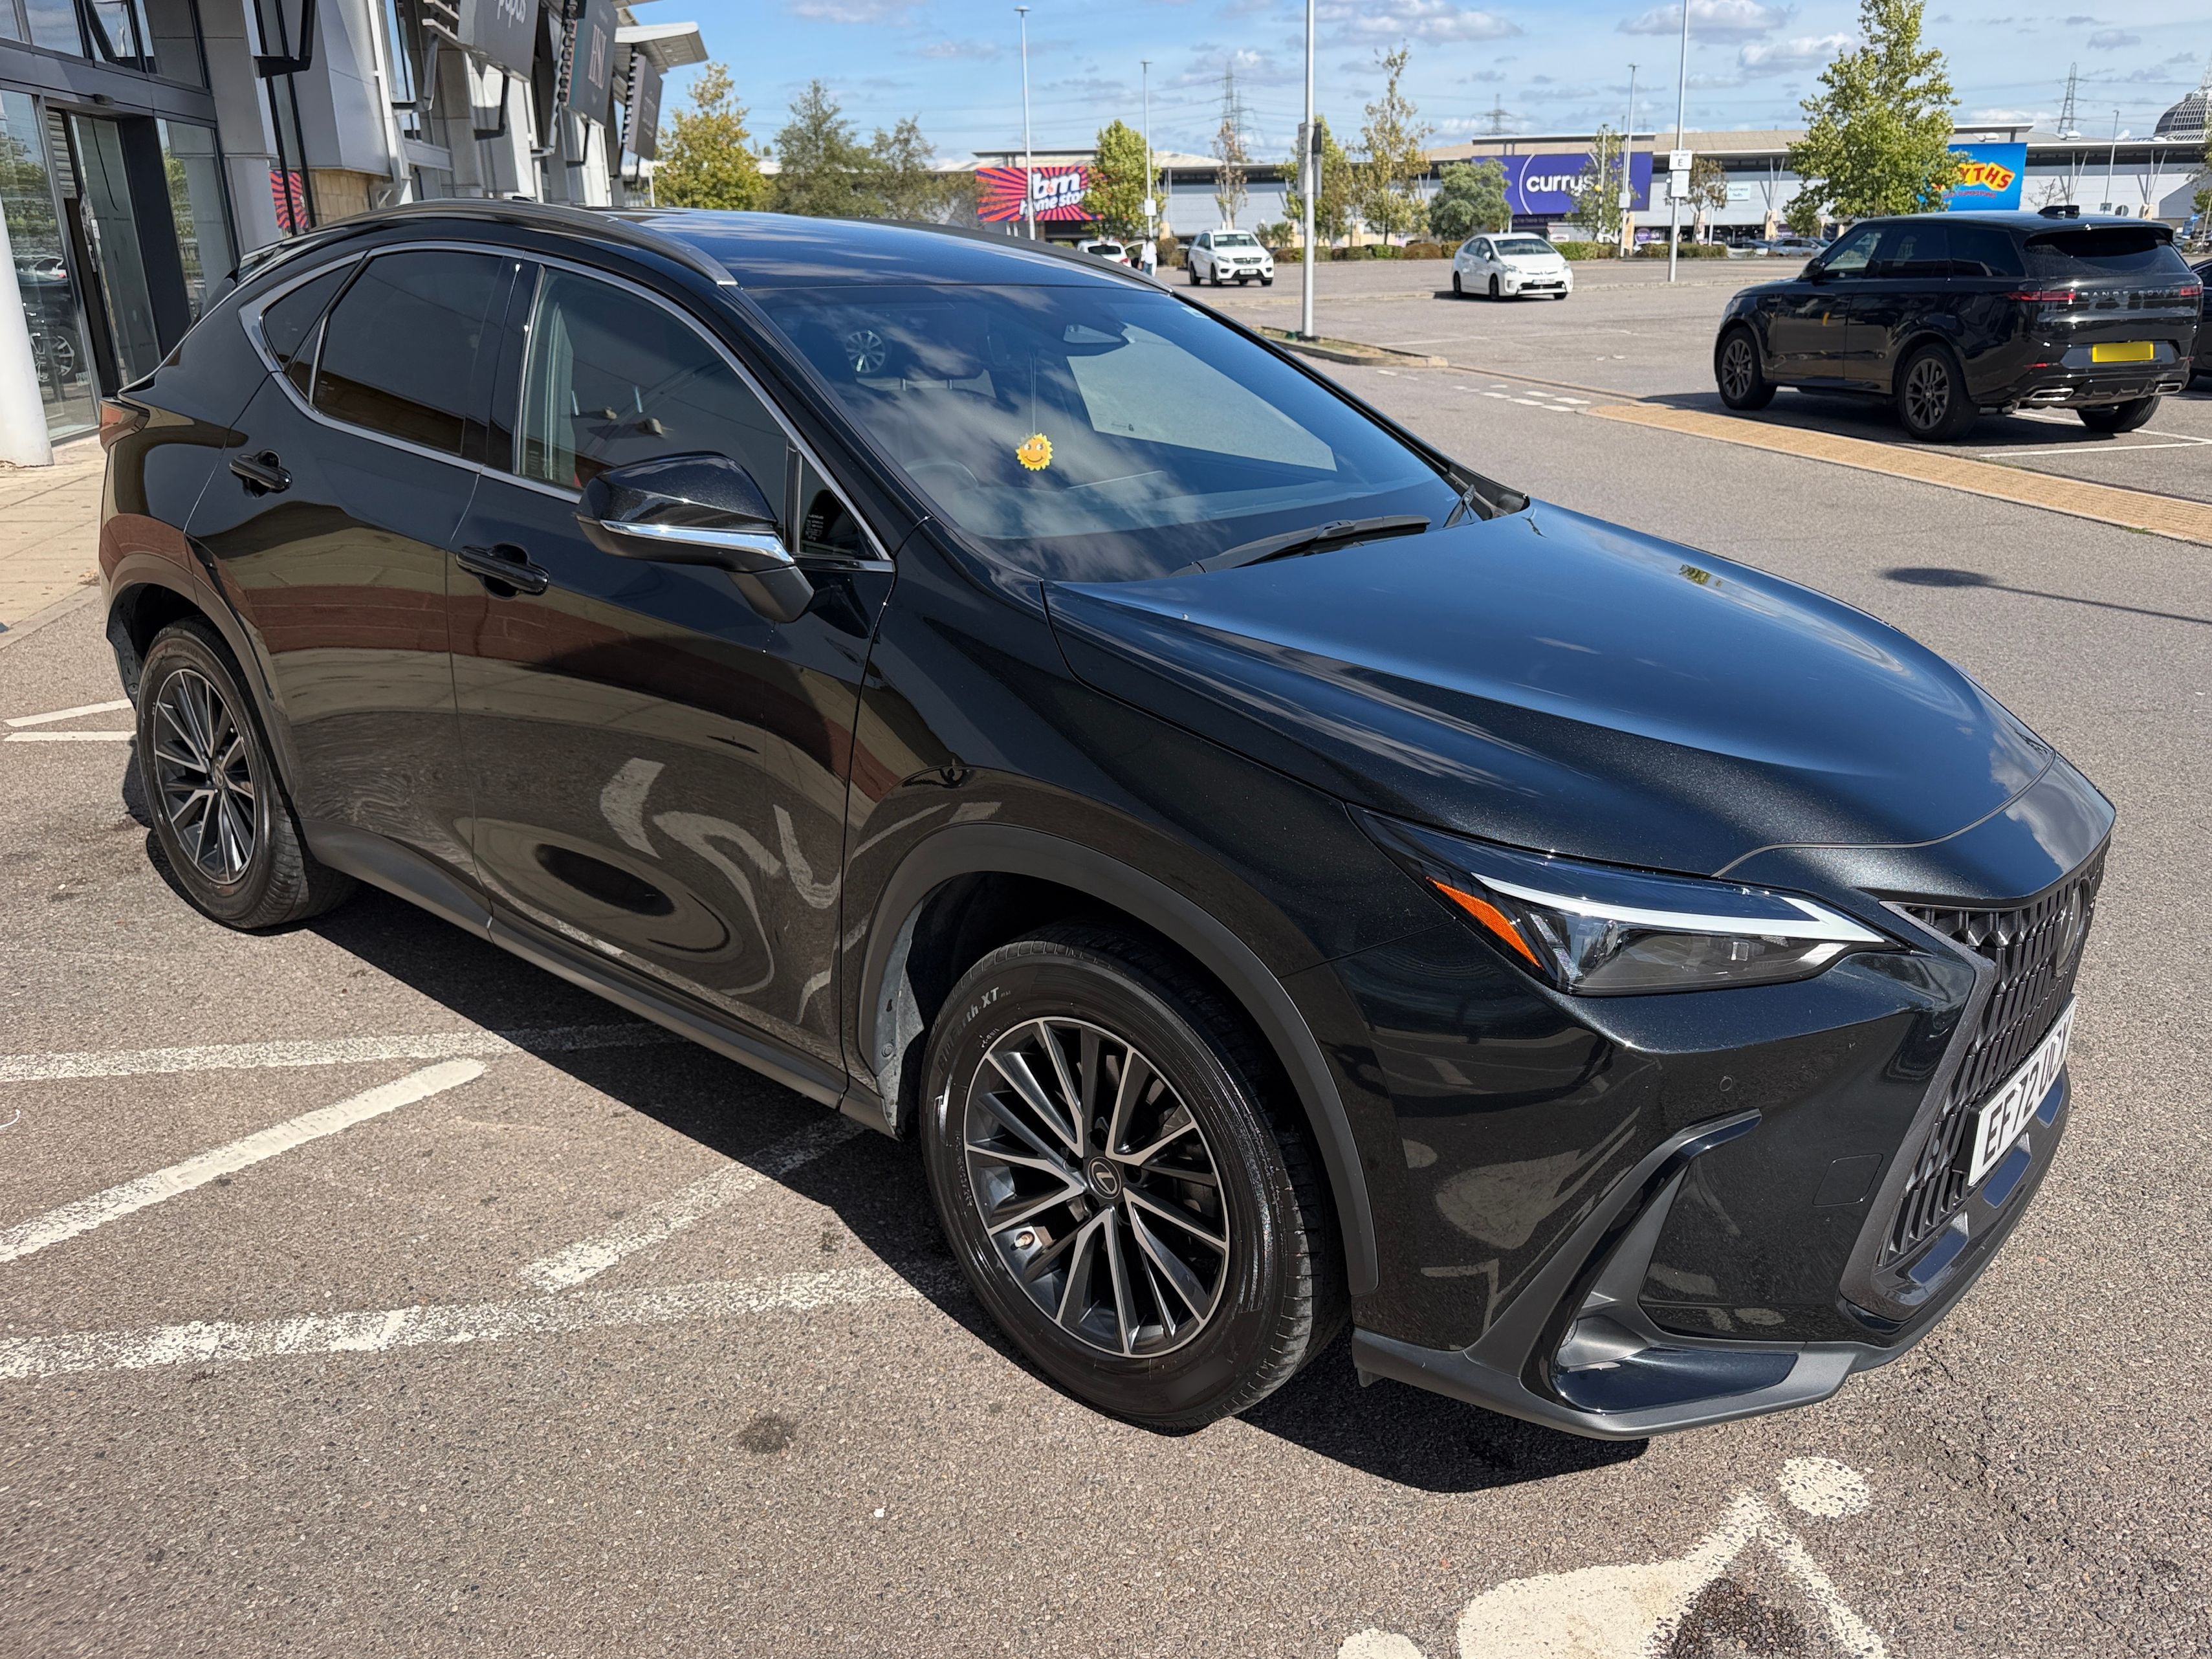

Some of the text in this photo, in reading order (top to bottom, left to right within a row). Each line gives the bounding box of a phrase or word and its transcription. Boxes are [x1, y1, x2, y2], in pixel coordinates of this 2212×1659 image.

[1526, 175, 1595, 197] currys
[1957, 166, 2012, 189] YTHS
[1019, 195, 1058, 215] hme
